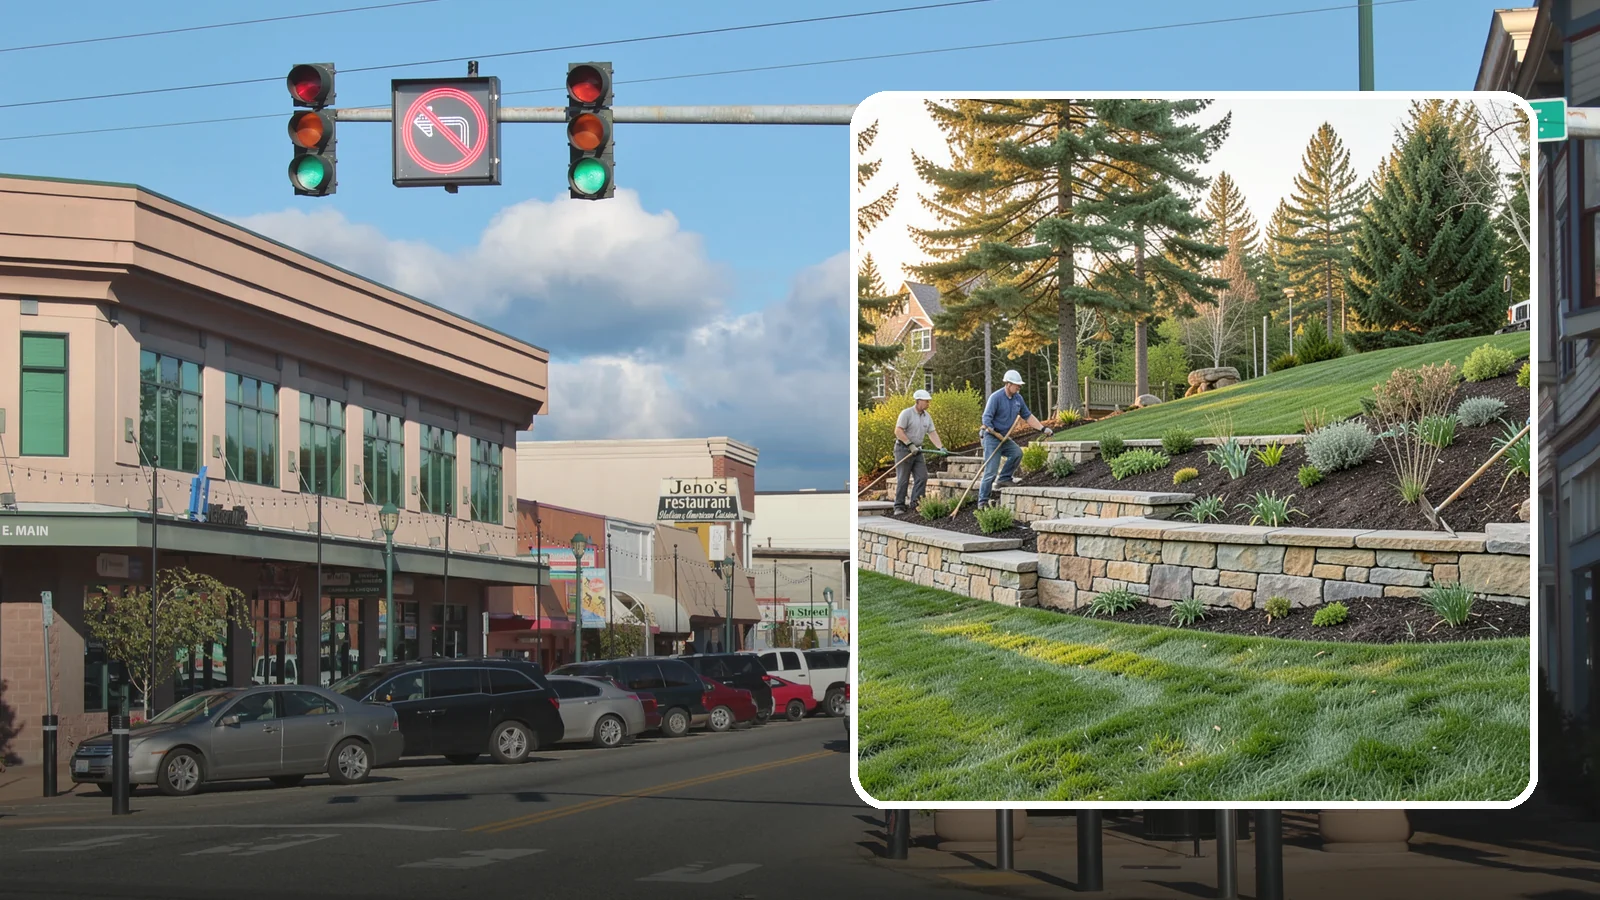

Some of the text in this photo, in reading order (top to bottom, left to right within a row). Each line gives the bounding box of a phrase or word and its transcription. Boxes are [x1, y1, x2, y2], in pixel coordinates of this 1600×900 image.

[669, 479, 727, 494] Jeno's
[665, 496, 731, 509] restaurant
[2, 525, 49, 536] E. MAIN
[797, 607, 829, 617] Street
[791, 618, 824, 627] lass
